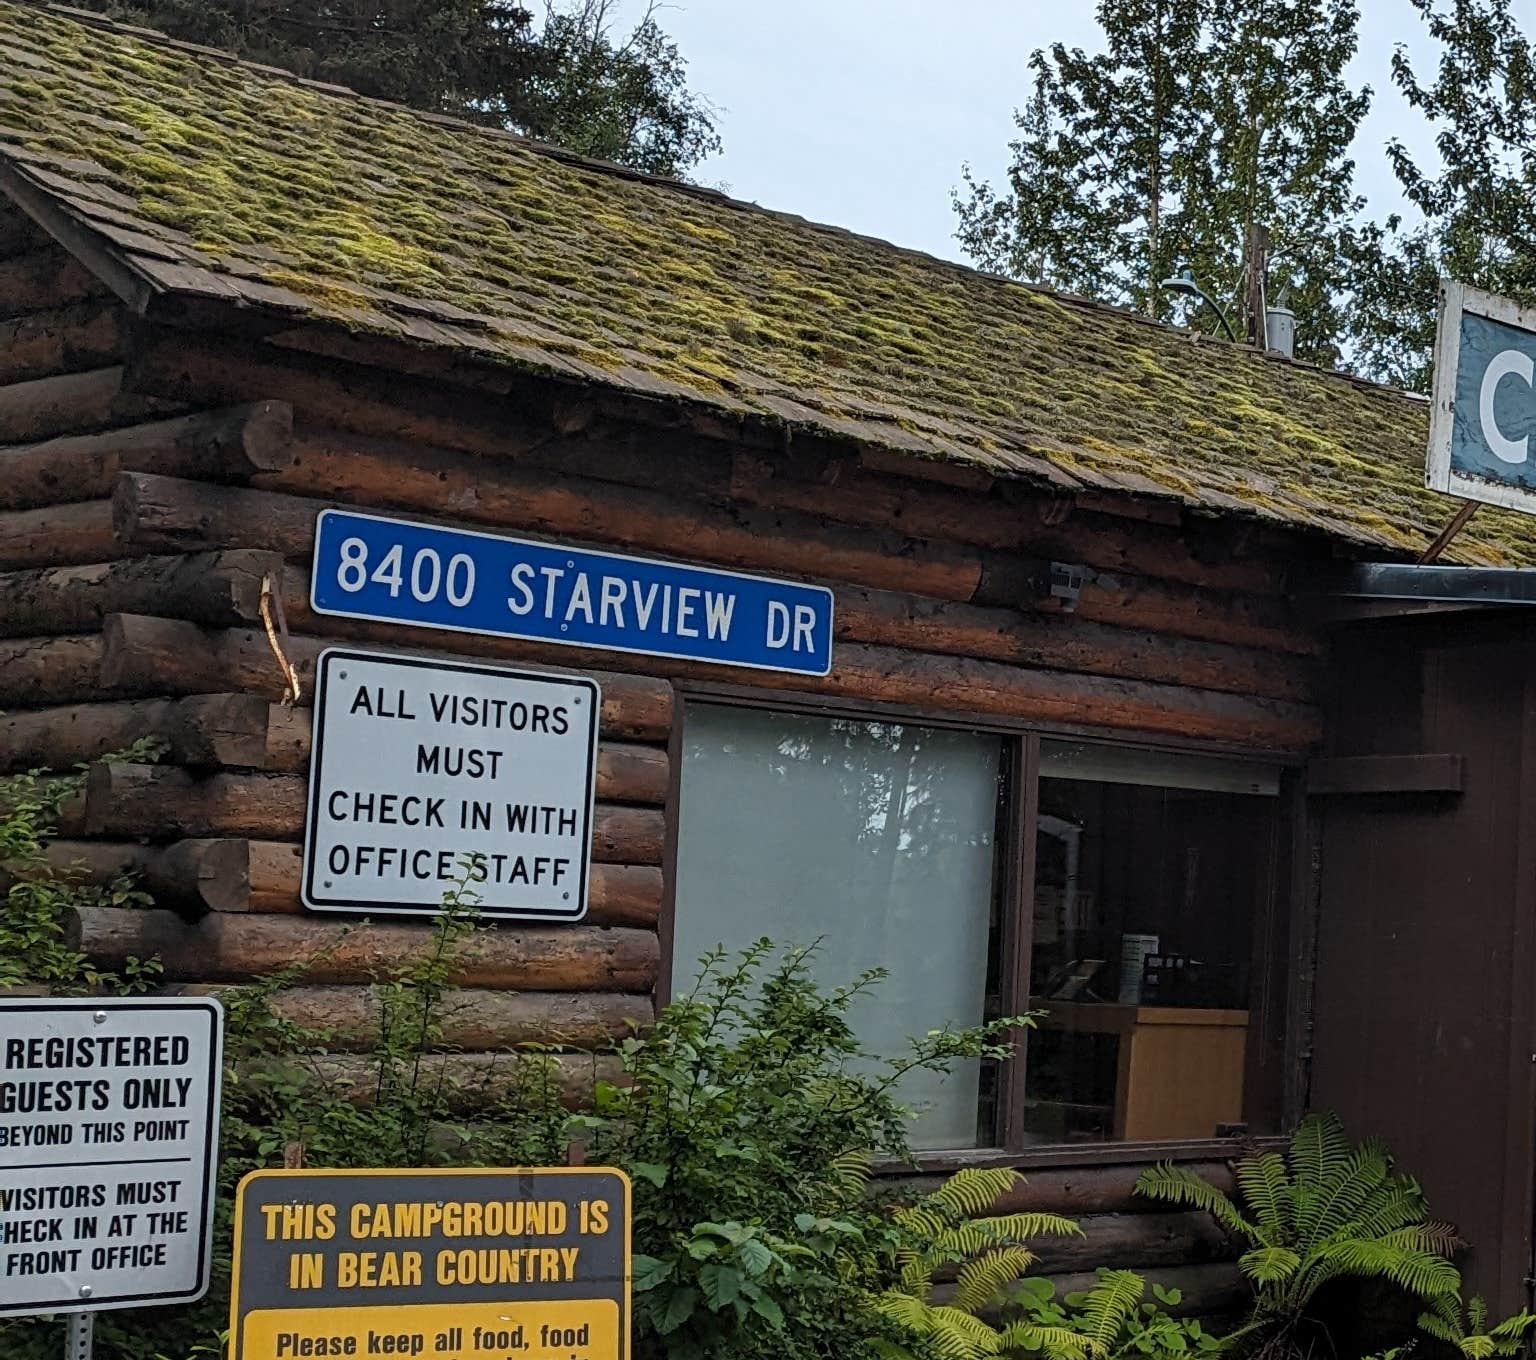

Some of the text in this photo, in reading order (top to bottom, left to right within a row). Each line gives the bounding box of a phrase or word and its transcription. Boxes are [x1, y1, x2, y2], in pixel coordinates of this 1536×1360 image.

[337, 537, 816, 654] 8400 STARVIEW DR
[350, 685, 569, 735] ALL VISITORS
[416, 744, 503, 780] MUST
[328, 790, 577, 837] CHECK IN WITH
[328, 844, 570, 887] OFFICE STAFF
[5, 1035, 190, 1070] REGISTERED
[0, 1077, 193, 1114] GUESTS ONLY
[0, 1119, 190, 1147] BEYOND THIS POINT
[0, 1180, 182, 1212] VISITORS MUST
[0, 1211, 189, 1245] HECK IN AT THE
[260, 1199, 610, 1240] THIS CAMPGROUND IS
[6, 1243, 168, 1277] FRONT OFFICE
[290, 1247, 580, 1289] IN BEAR COUNTRY
[275, 1323, 589, 1358] Please keep all food, food
